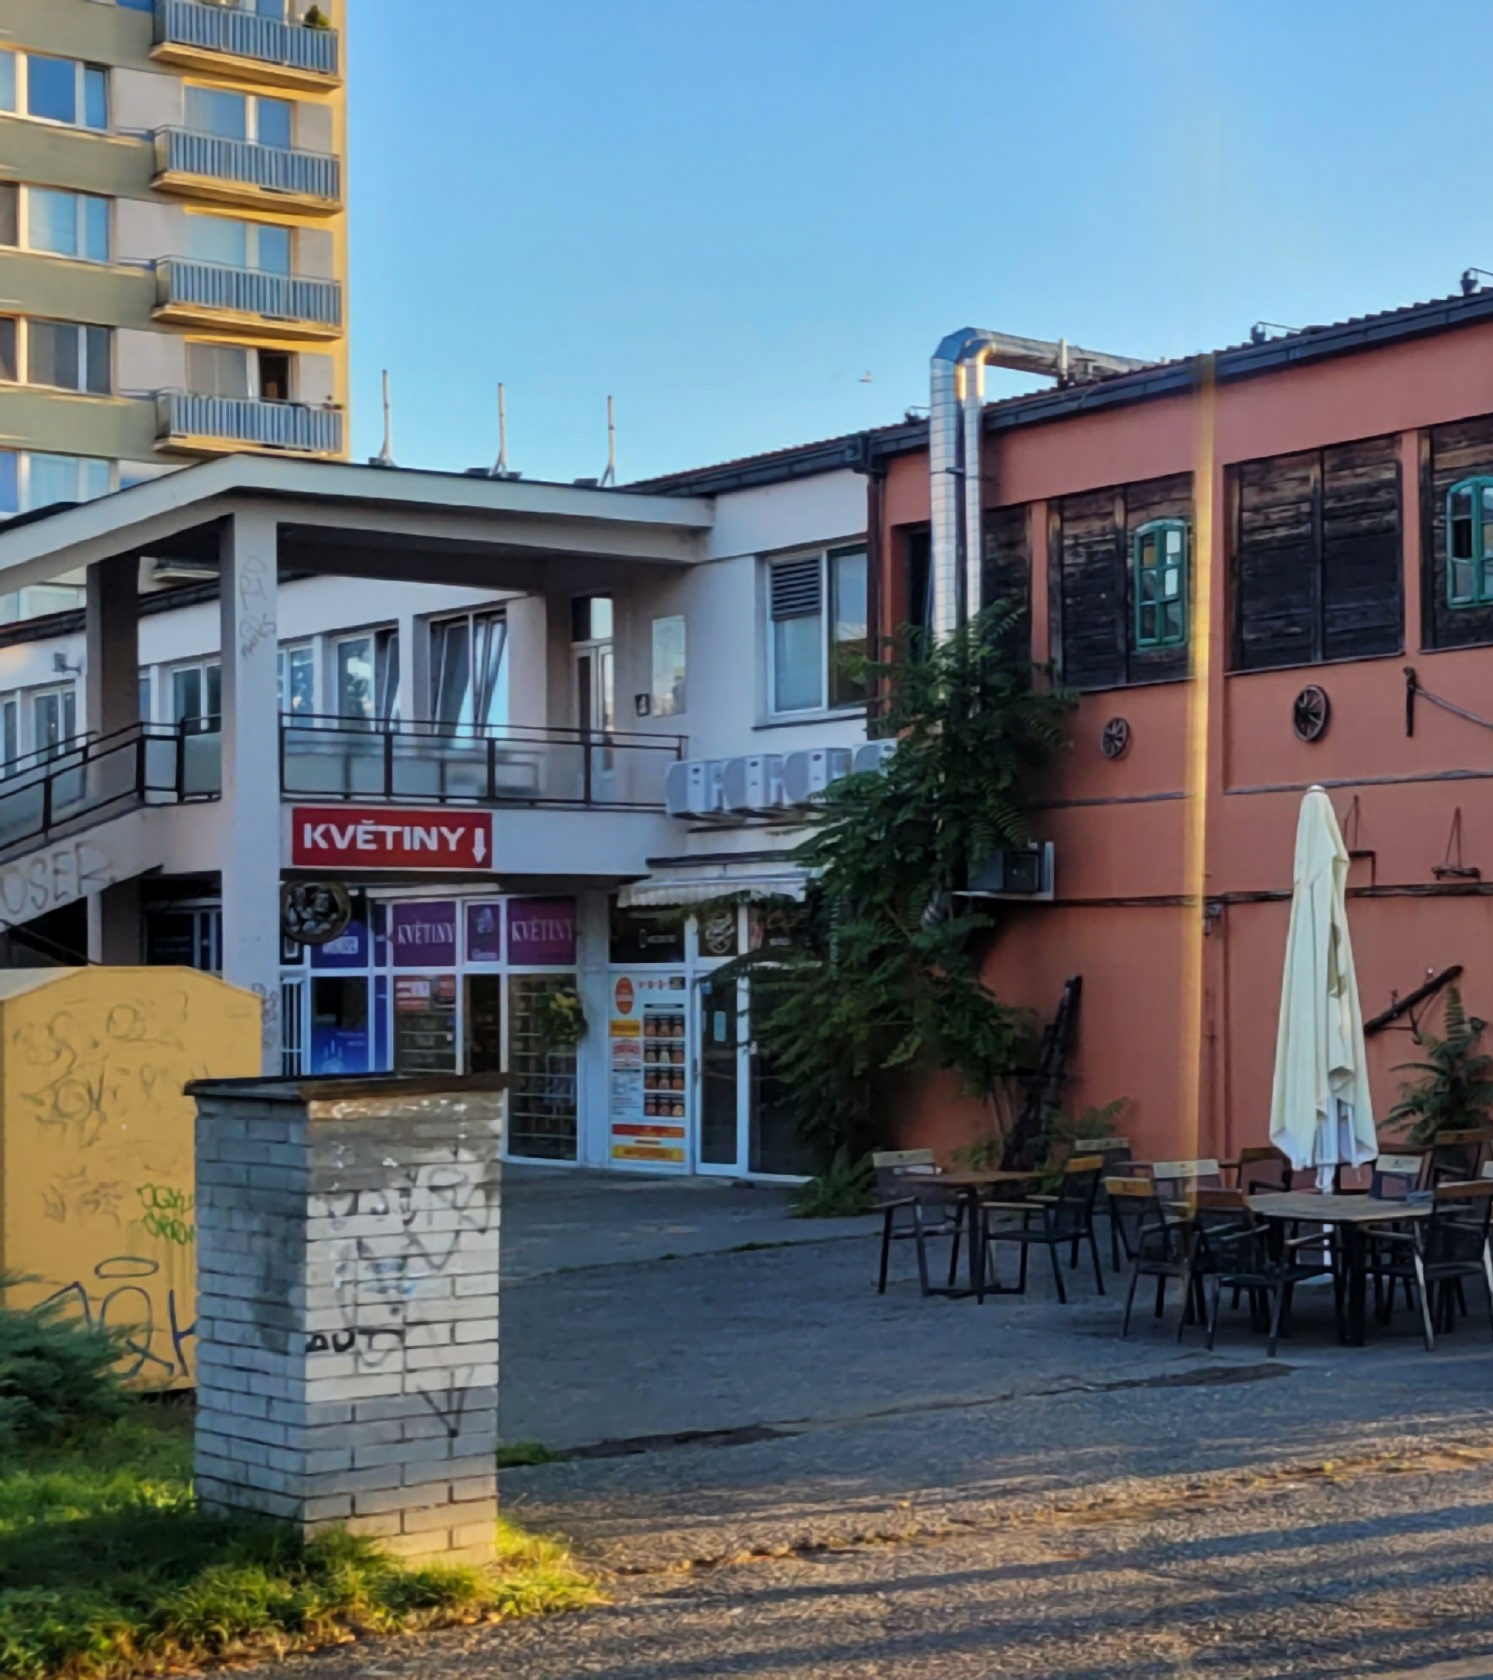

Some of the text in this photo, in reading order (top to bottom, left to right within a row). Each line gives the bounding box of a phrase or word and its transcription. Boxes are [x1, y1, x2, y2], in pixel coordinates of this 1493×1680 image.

[303, 810, 466, 851] KVĚTINY
[398, 919, 456, 945] KVĚTINY
[511, 916, 574, 943] KVĚTINY
